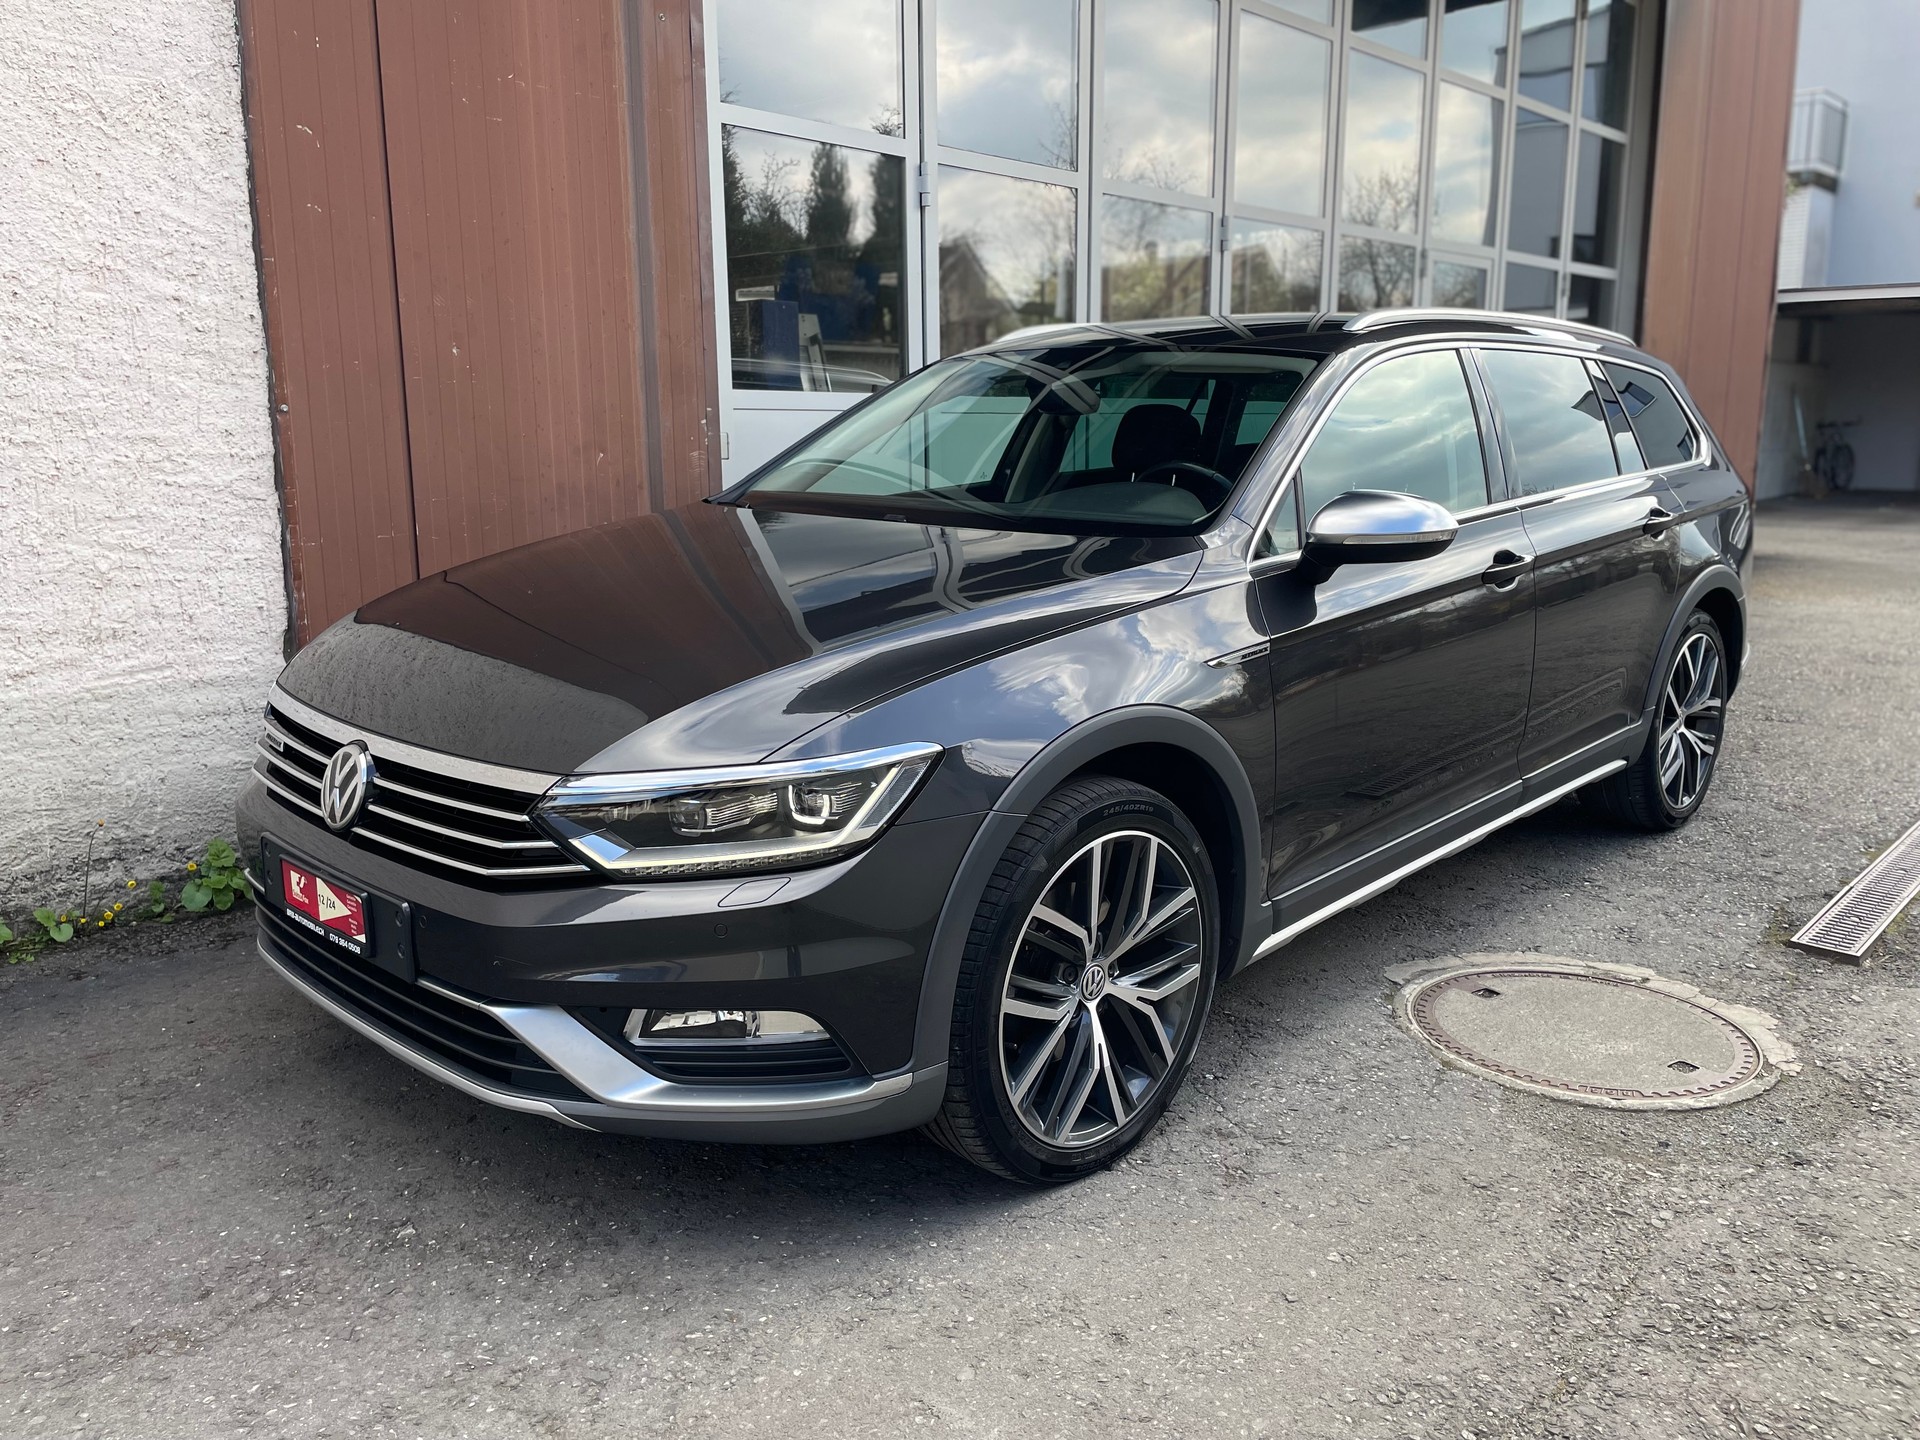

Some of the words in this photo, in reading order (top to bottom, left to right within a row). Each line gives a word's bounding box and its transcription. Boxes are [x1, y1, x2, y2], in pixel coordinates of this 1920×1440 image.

[322, 743, 364, 831] VW
[1103, 803, 1154, 816] 245/40ZR19
[1083, 966, 1105, 1000] VW
